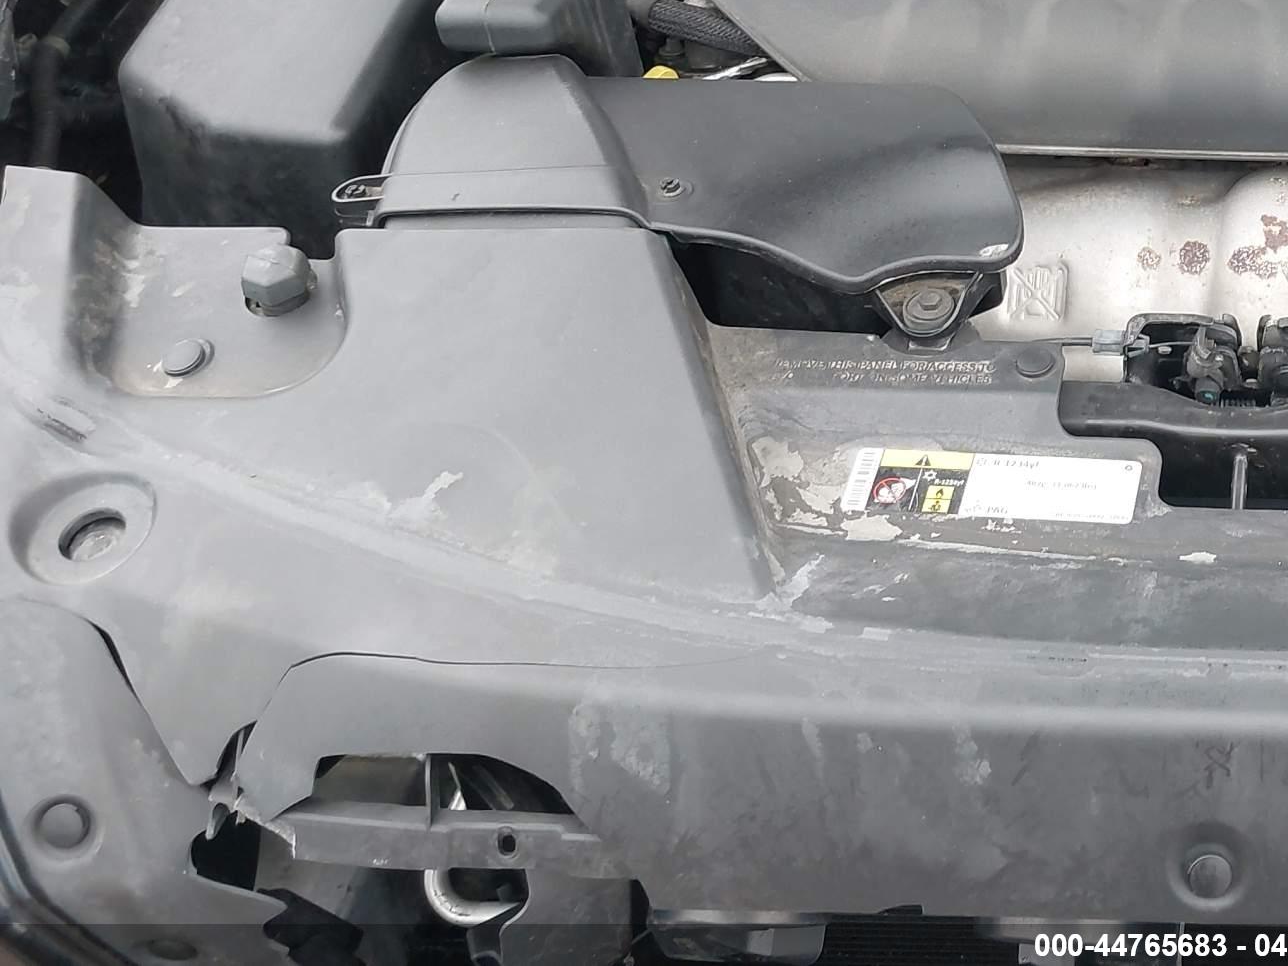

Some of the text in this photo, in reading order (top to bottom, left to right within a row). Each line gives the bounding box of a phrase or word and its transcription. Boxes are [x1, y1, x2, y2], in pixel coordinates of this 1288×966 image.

[858, 360, 898, 370] PANEL
[901, 360, 927, 371] FOR
[927, 361, 977, 372] ACCESS
[977, 360, 997, 373] TO
